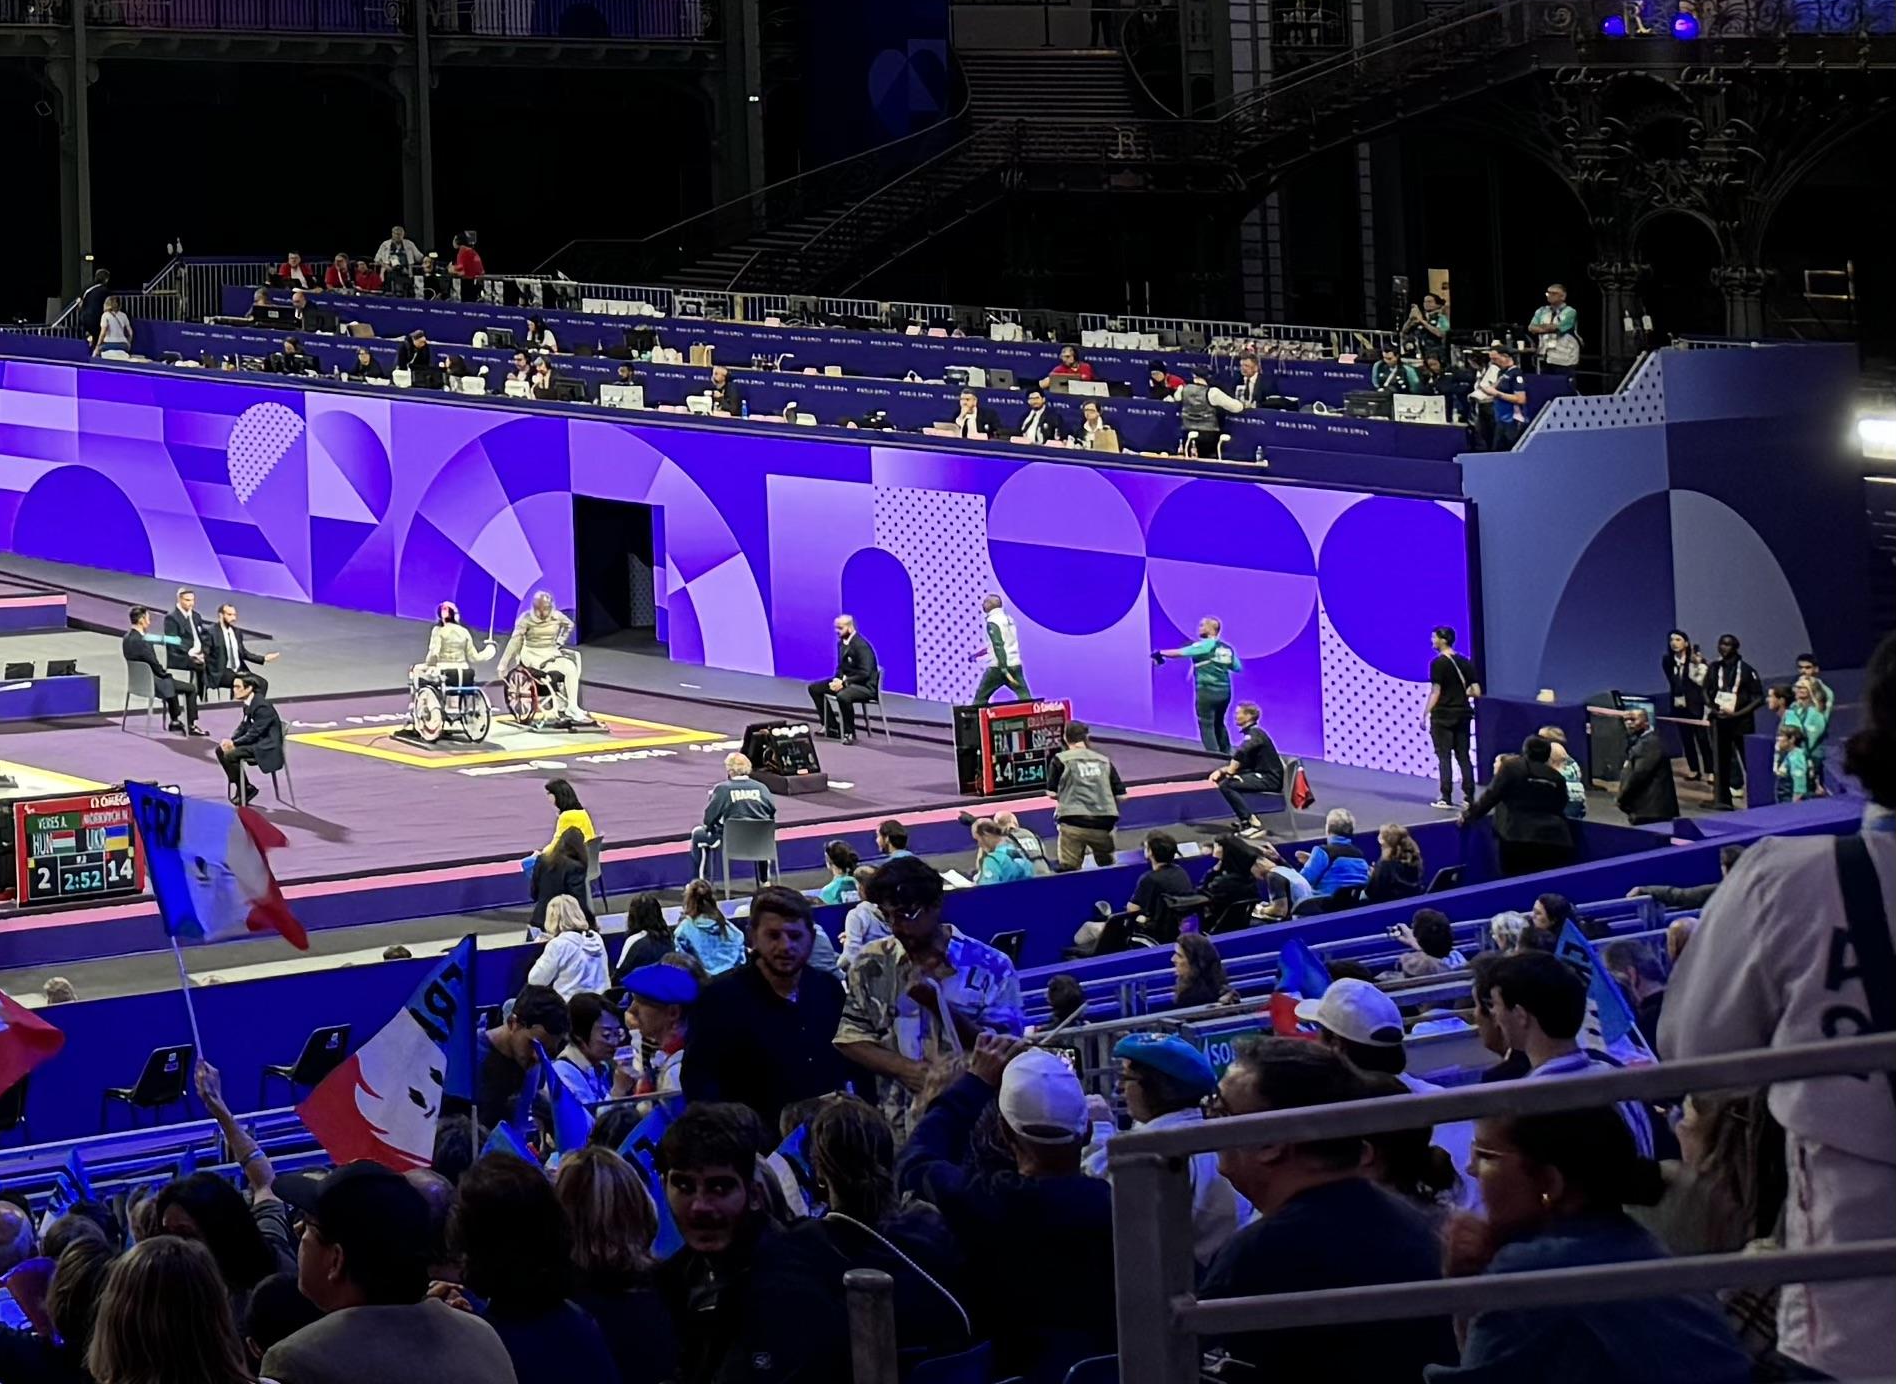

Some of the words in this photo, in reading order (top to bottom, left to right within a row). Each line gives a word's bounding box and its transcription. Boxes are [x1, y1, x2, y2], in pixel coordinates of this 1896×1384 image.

[1017, 765, 1044, 782] 2:54
[730, 788, 762, 804] FRANCE
[37, 867, 51, 889] 2
[64, 870, 101, 891] 2:52
[108, 858, 134, 882] 14
